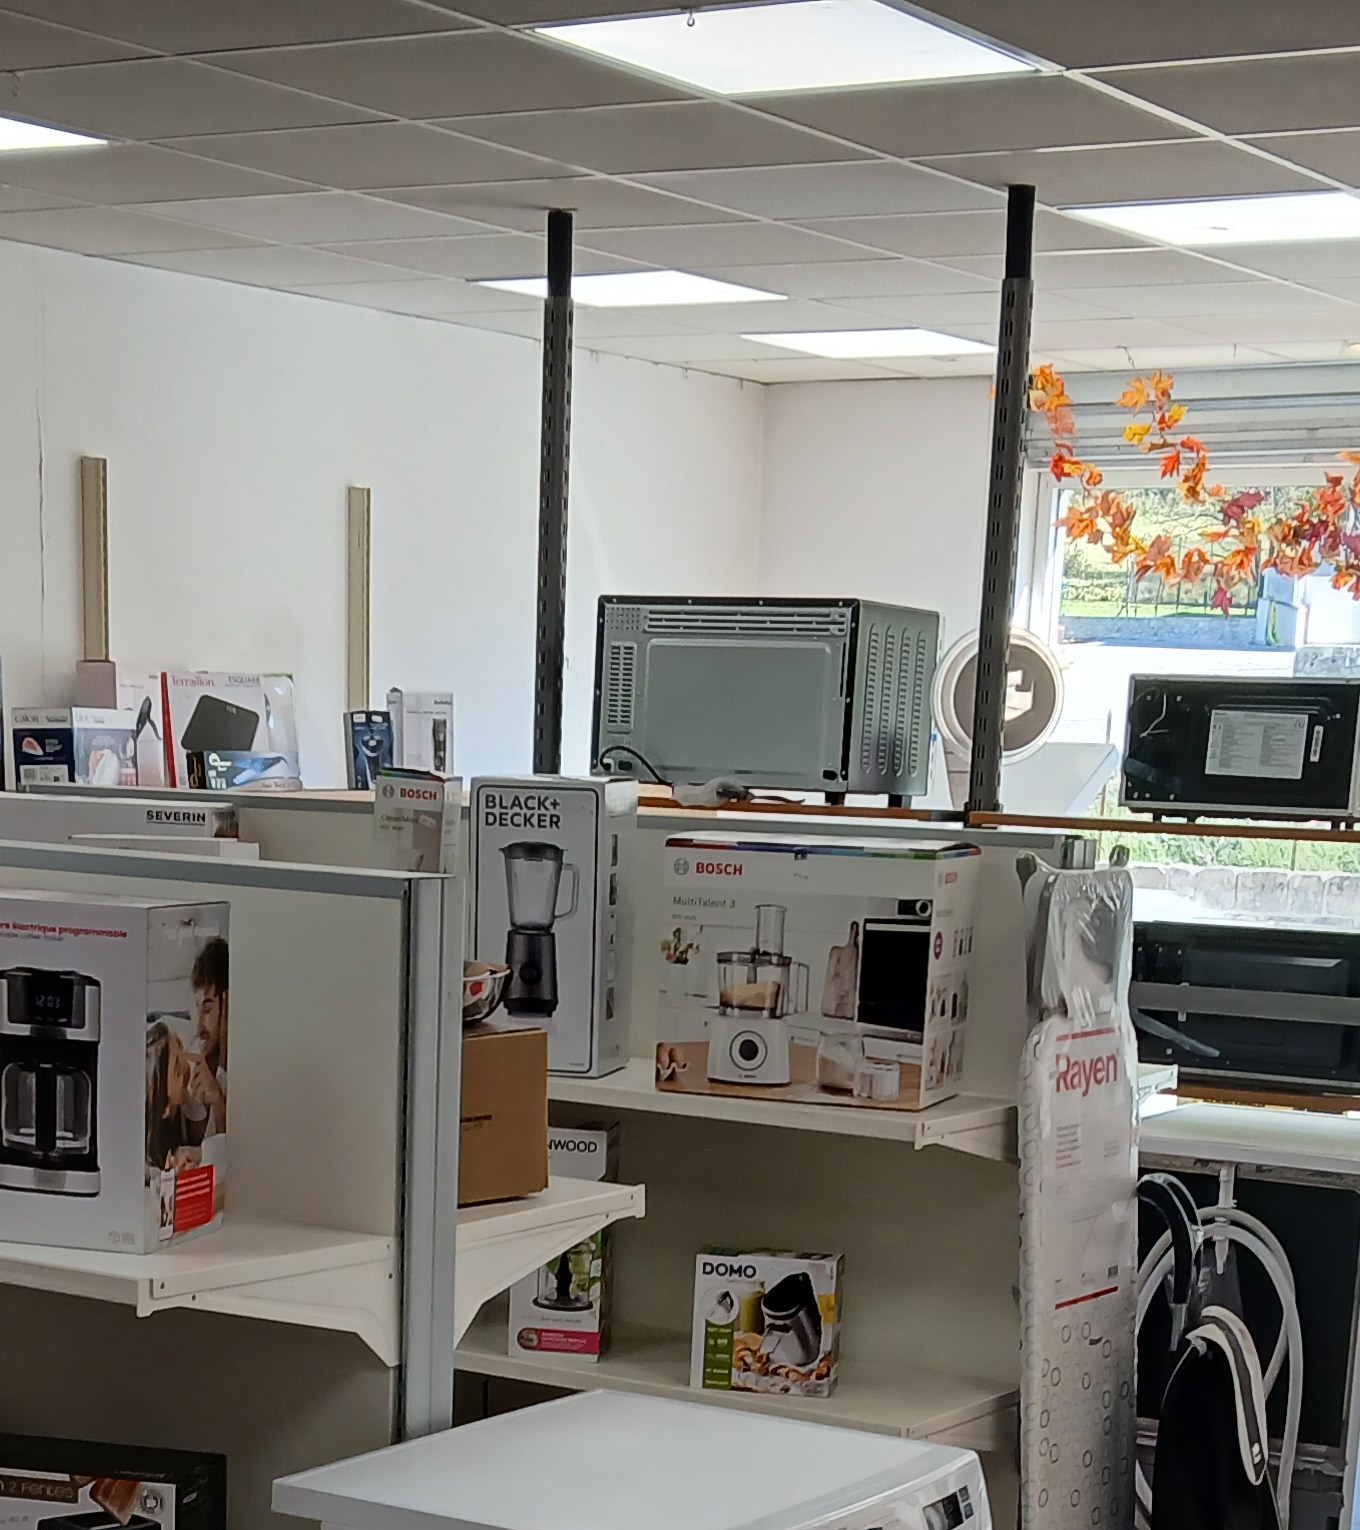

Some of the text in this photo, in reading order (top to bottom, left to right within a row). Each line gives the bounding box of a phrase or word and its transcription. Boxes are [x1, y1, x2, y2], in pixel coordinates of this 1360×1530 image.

[400, 788, 438, 801] BOSCH
[485, 794, 561, 811] BLACK+
[146, 810, 206, 823] SEVERIN
[485, 811, 561, 829] DECKER
[696, 862, 743, 876] BOSCH
[1055, 1053, 1118, 1098] Rayen
[548, 1139, 598, 1154] WOOD
[702, 1262, 757, 1279] DOMO
